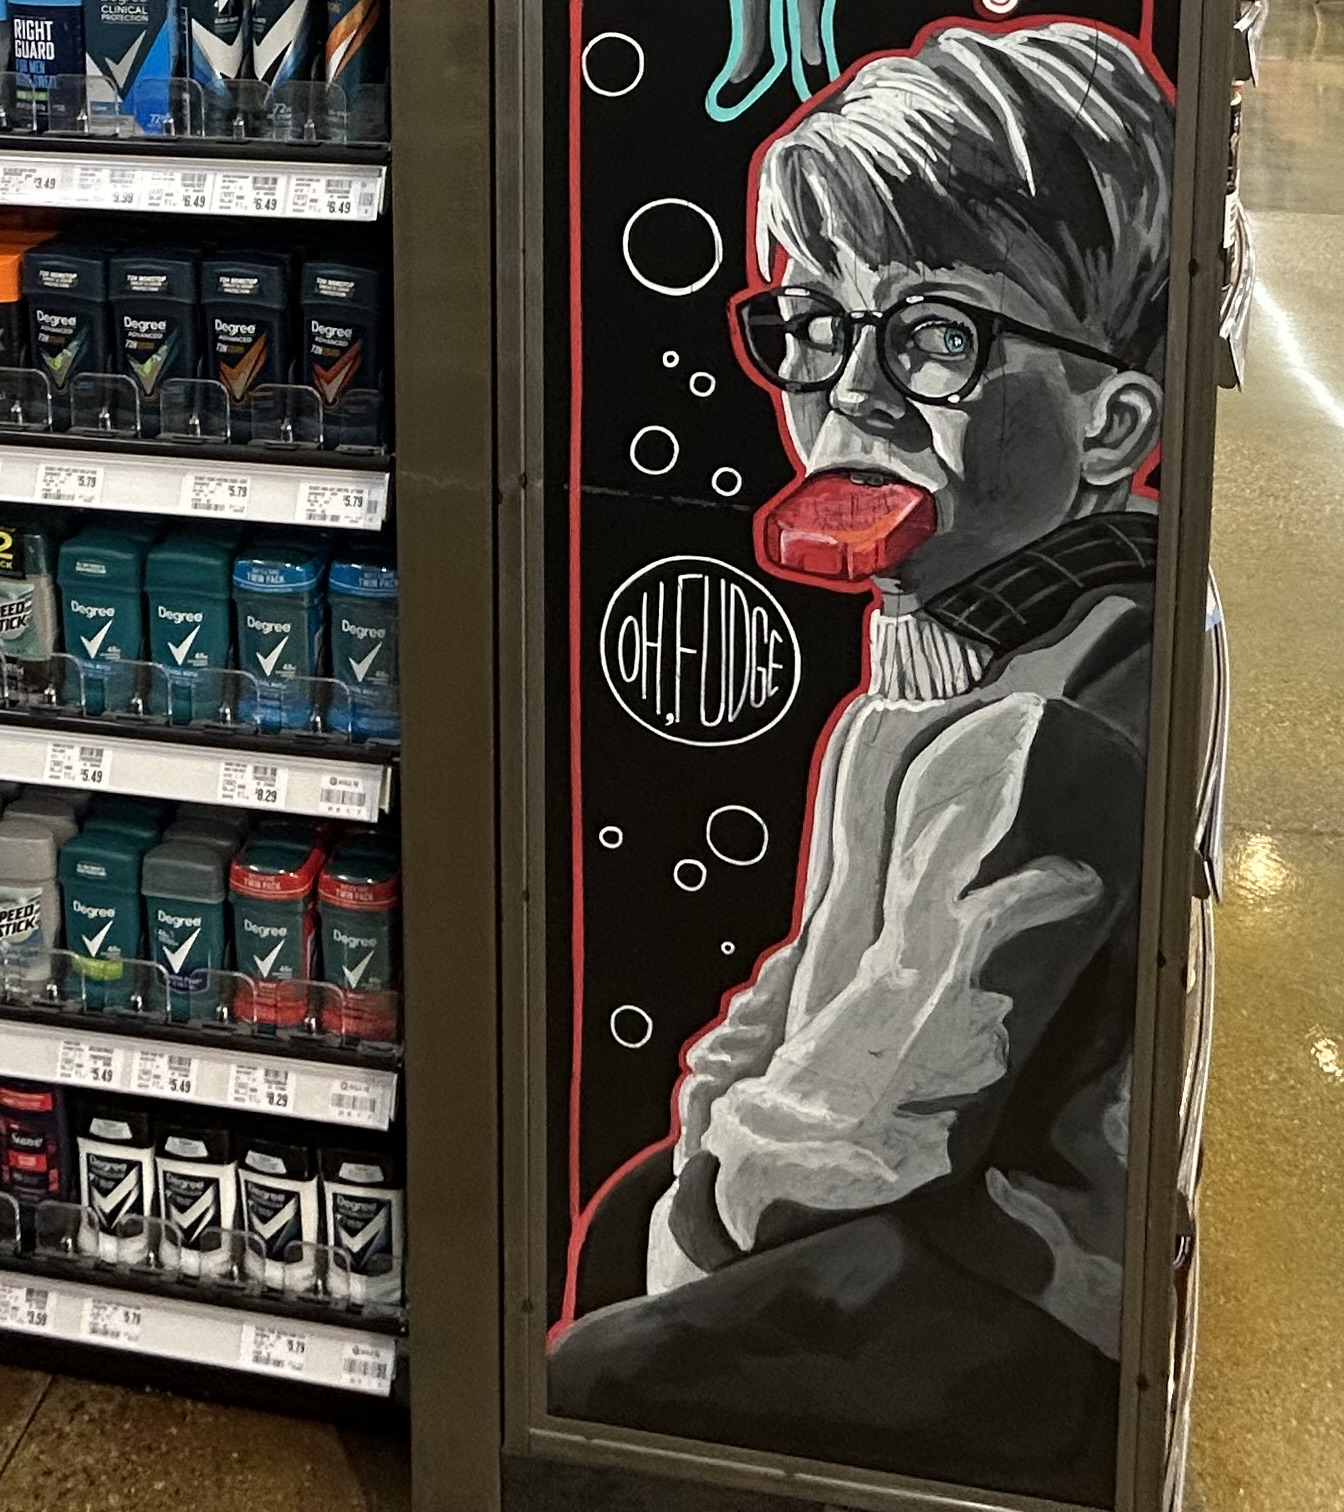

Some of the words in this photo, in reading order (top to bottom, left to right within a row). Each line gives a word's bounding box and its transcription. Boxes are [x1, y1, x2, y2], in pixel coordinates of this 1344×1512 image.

[101, 5, 148, 16] CLINICAL
[14, 19, 53, 41] RIGHT
[14, 40, 54, 60] GUARD
[36, 310, 76, 326] Degree
[124, 316, 167, 332] Degree
[215, 319, 255, 335] Degree
[311, 321, 353, 338] Degree
[71, 601, 115, 617] Degree
[158, 606, 203, 623] Degree
[247, 616, 291, 633] Degree
[675, 574, 783, 727] FUDGE
[73, 901, 115, 918] Degree
[158, 910, 201, 926] Degree
[244, 919, 287, 937] Degree
